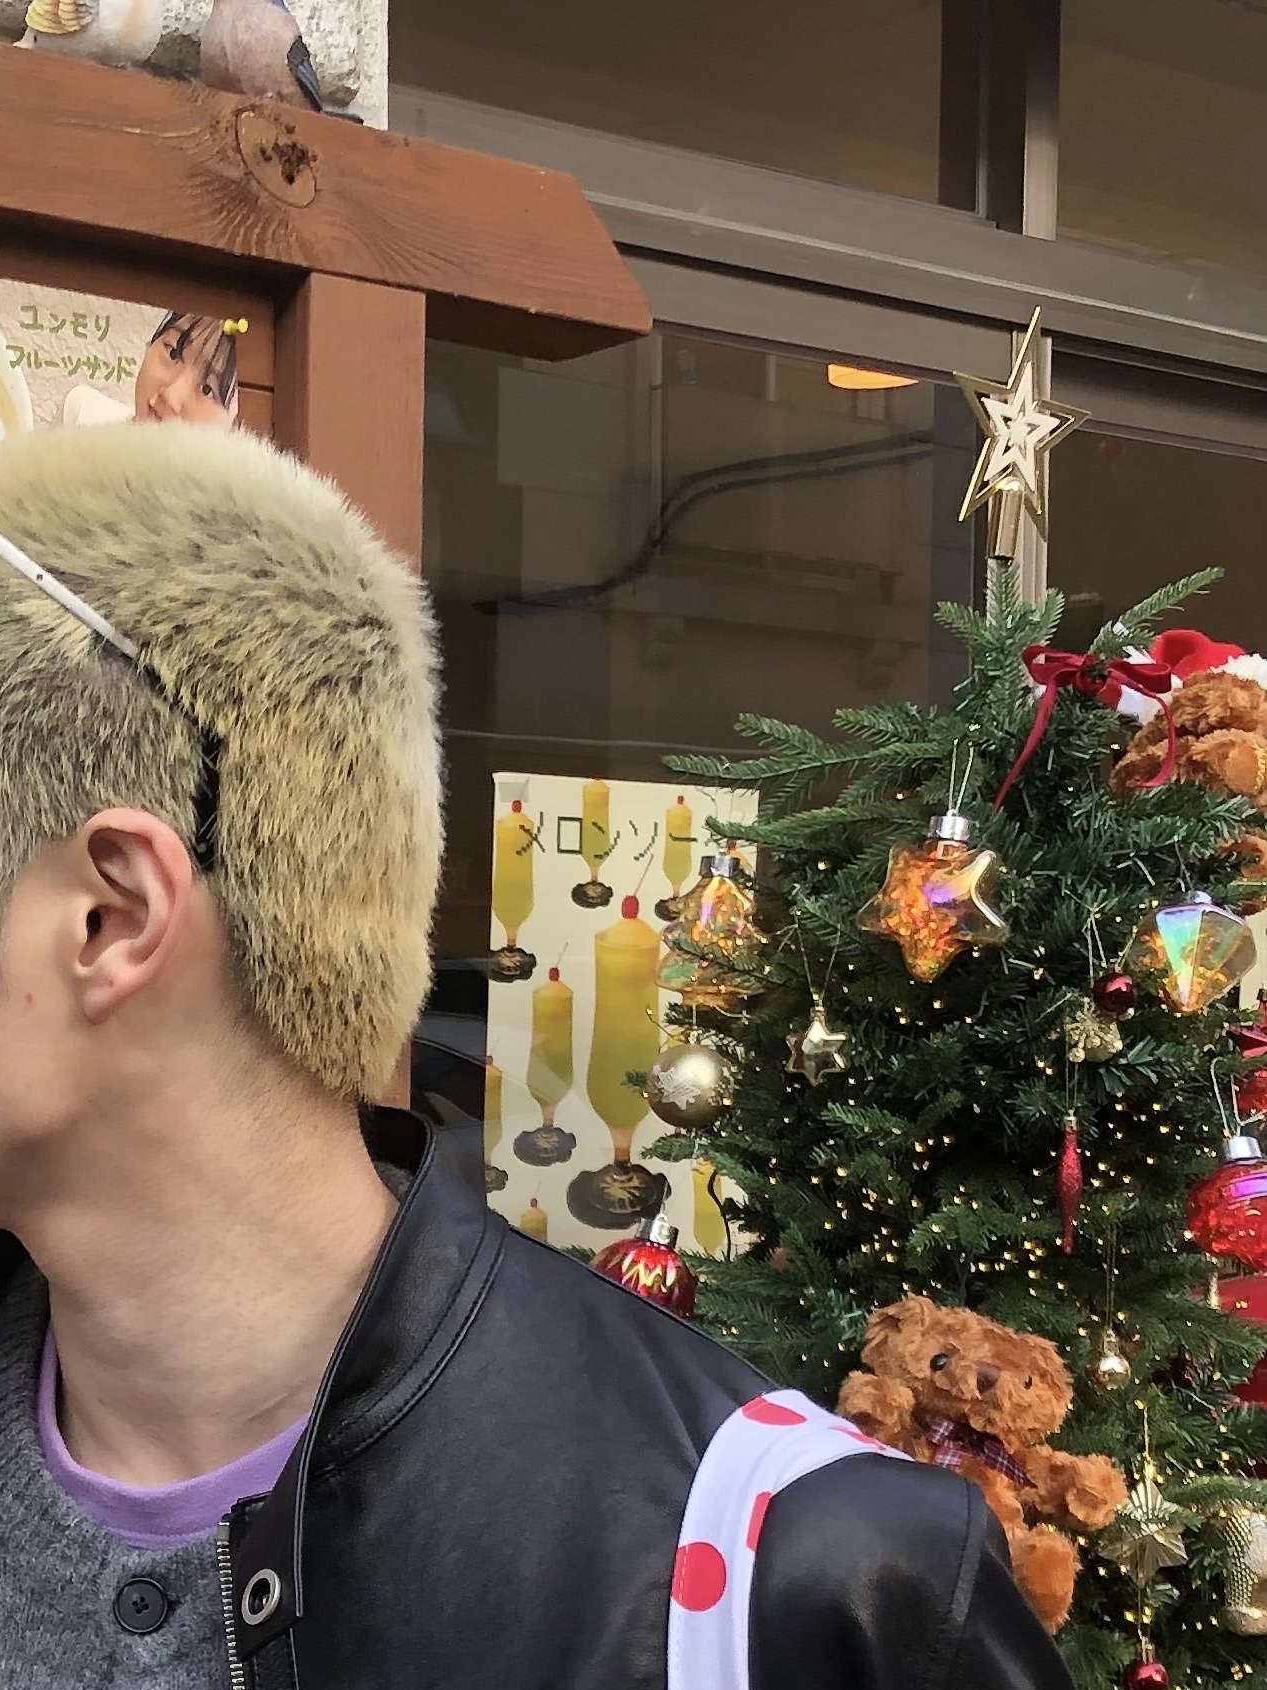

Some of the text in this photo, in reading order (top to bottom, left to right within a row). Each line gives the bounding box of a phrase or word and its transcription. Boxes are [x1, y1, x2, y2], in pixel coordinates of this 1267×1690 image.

[19, 305, 112, 342] ユンモリ
[5, 343, 137, 383] フルーツサンド
